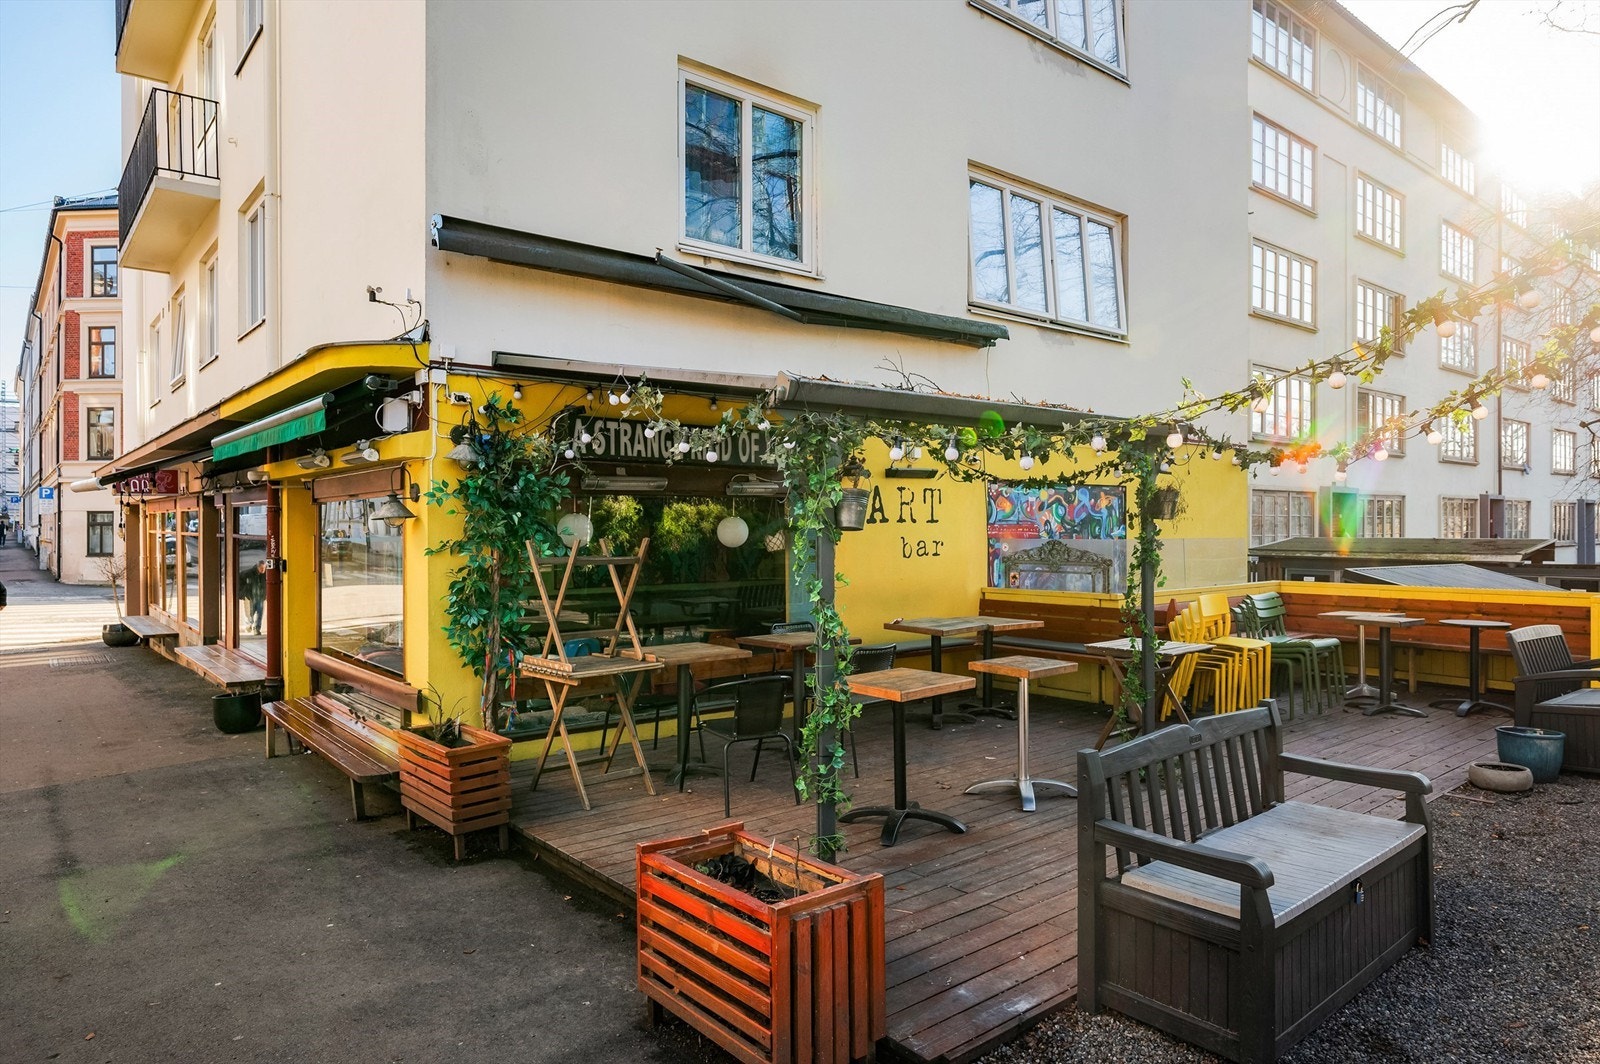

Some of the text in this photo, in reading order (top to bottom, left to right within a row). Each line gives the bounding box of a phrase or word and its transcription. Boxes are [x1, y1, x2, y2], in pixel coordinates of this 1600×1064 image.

[572, 418, 587, 454] A
[594, 420, 683, 460] STRANG
[738, 432, 759, 463] OF
[42, 488, 51, 498] P
[866, 485, 942, 524] ART
[900, 536, 944, 559] bar
